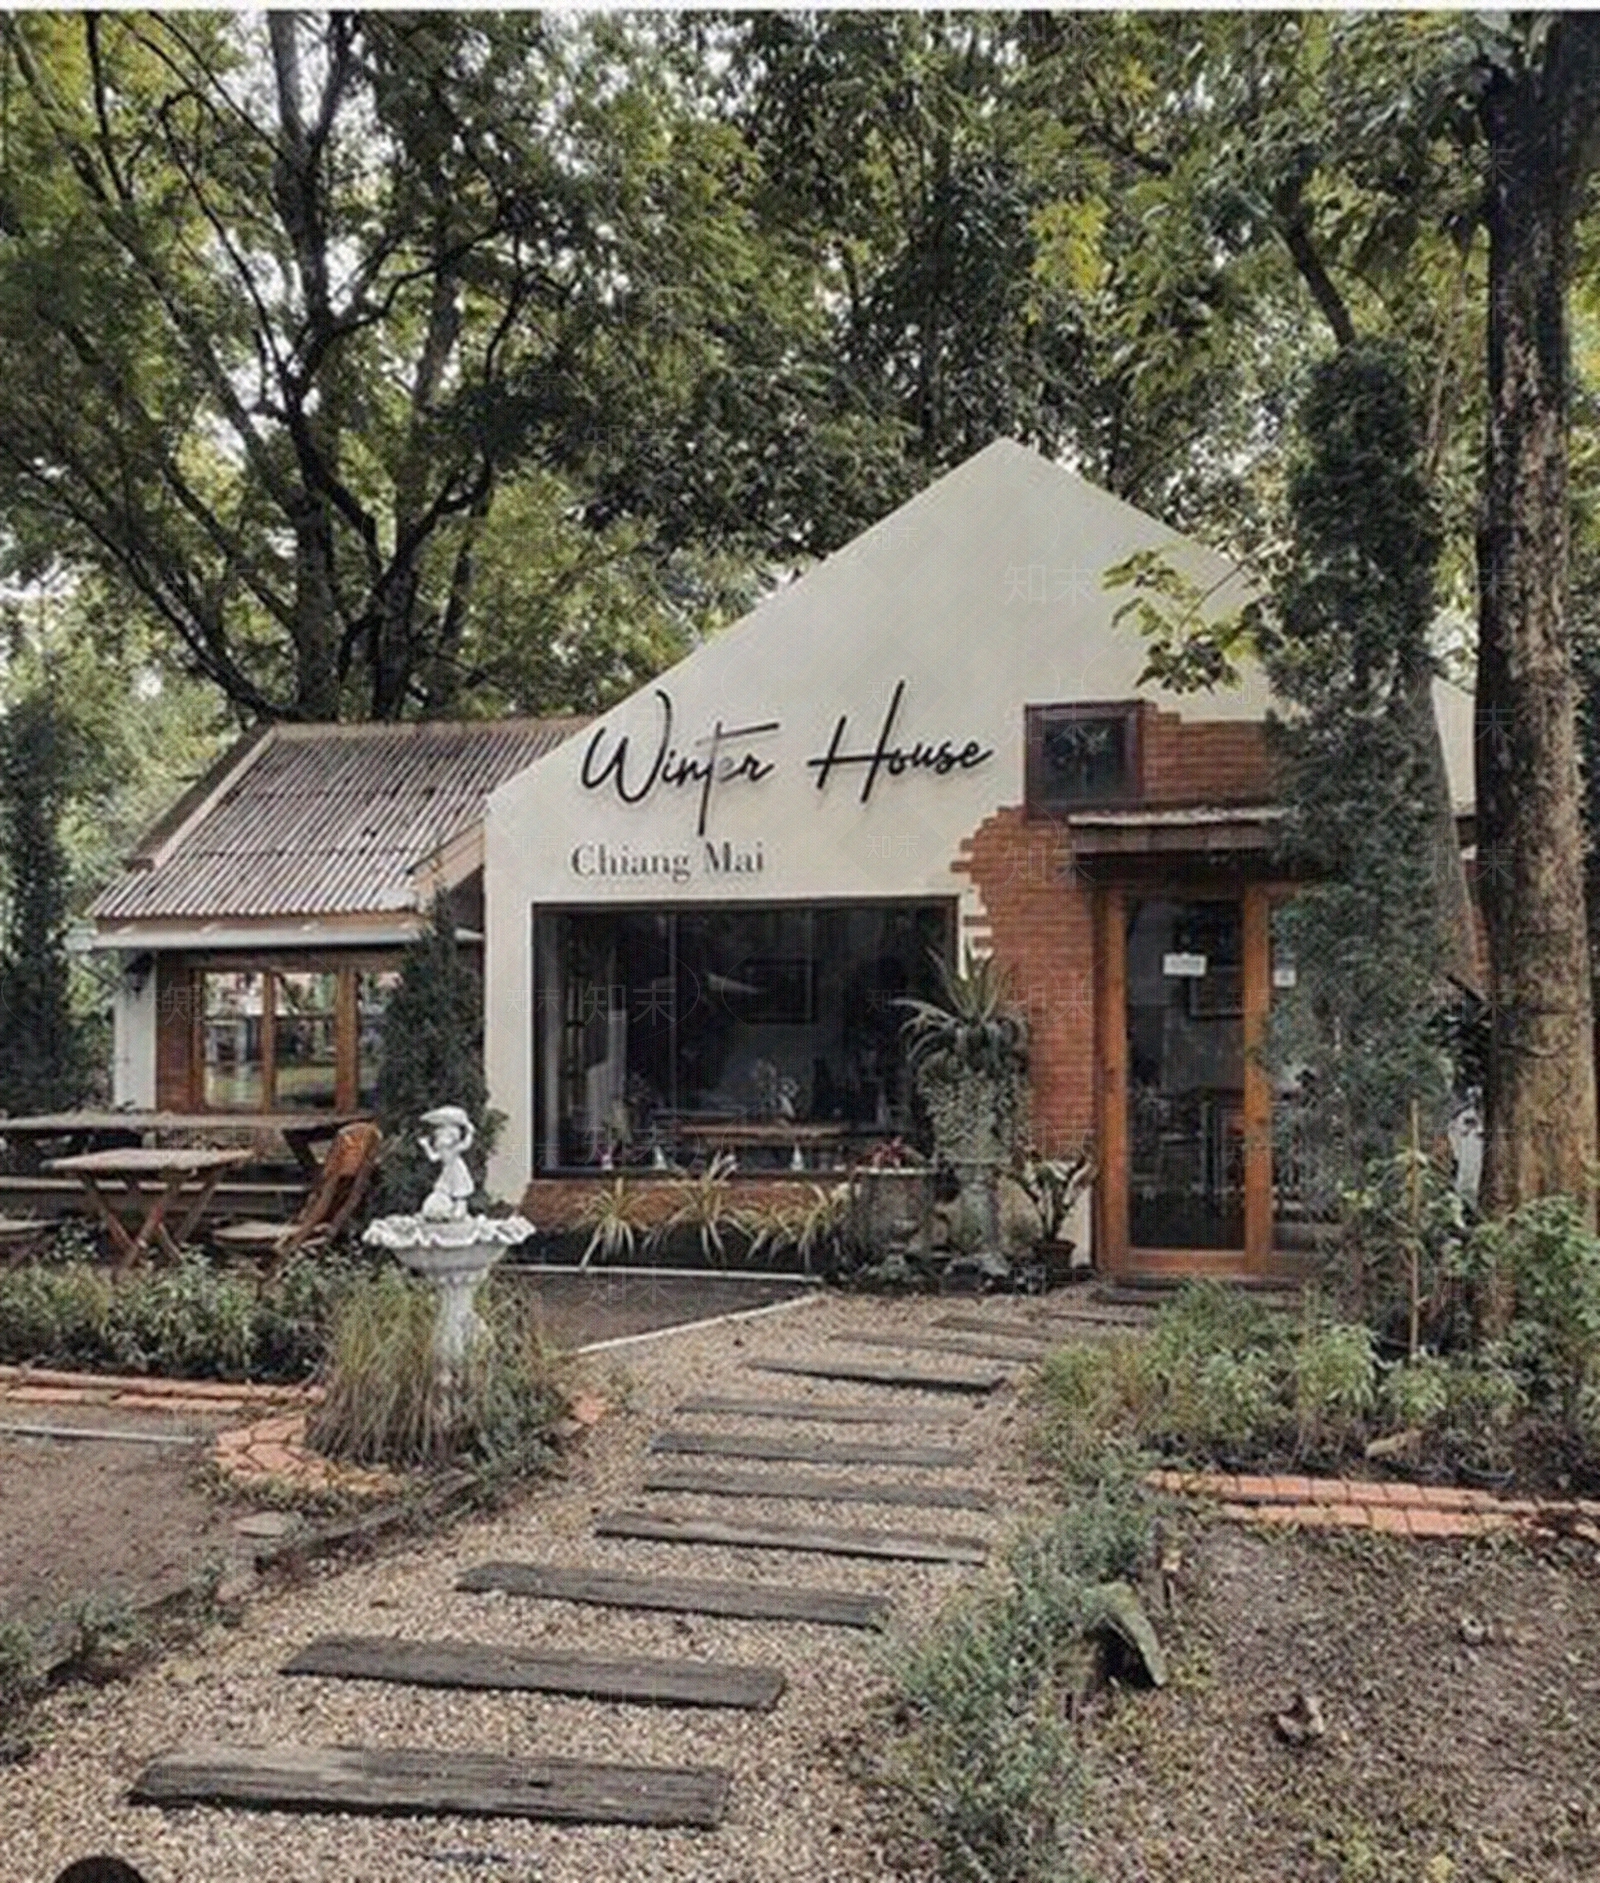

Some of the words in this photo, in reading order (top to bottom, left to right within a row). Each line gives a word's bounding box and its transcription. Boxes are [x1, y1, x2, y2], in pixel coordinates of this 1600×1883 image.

[580, 690, 780, 836] Winter
[807, 680, 994, 803] House
[571, 844, 691, 883] Chiang
[704, 841, 765, 873] Mai
